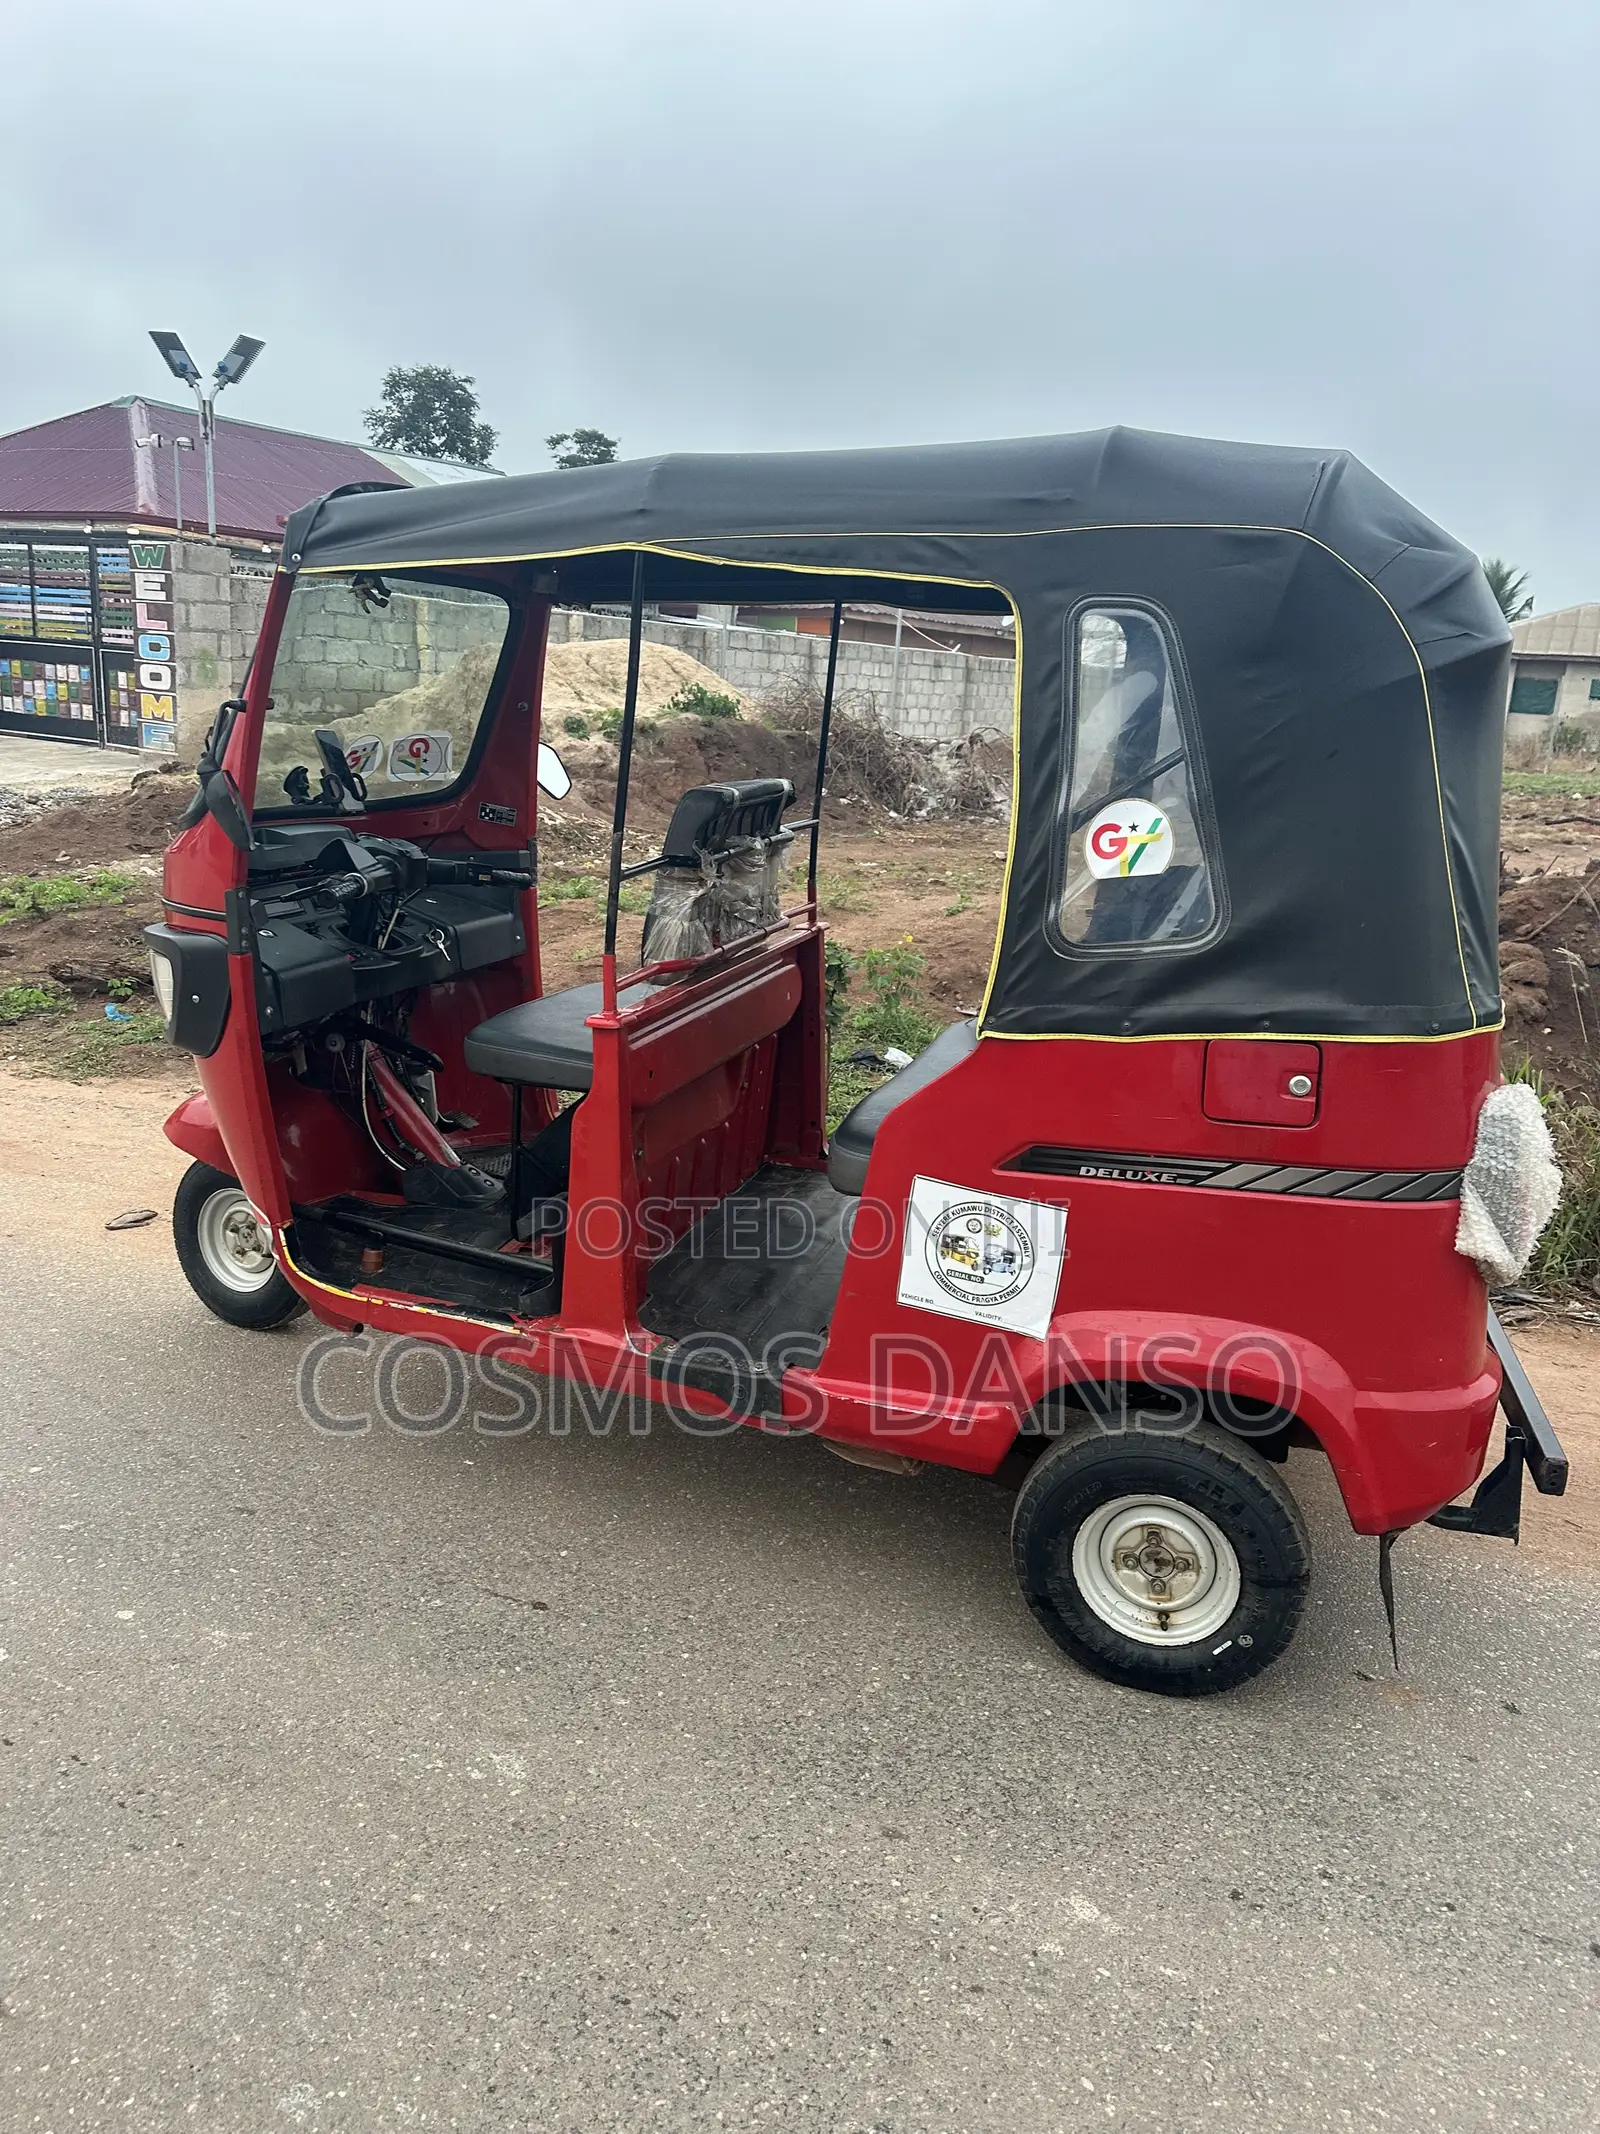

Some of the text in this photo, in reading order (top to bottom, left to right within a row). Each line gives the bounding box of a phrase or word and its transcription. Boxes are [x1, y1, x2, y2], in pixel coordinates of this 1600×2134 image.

[131, 545, 175, 751] WELCOME
[1078, 1166, 1178, 1183] DELUXE
[932, 1205, 1031, 1259] SEKYERE KUMAWU DISTRICT ASSEMBLY
[933, 1270, 970, 1302] COMMERCIAL
[998, 1284, 1021, 1302] PERMIT
[948, 1270, 983, 1283] SERIAL NO.
[901, 1292, 924, 1303] VEHICLE
